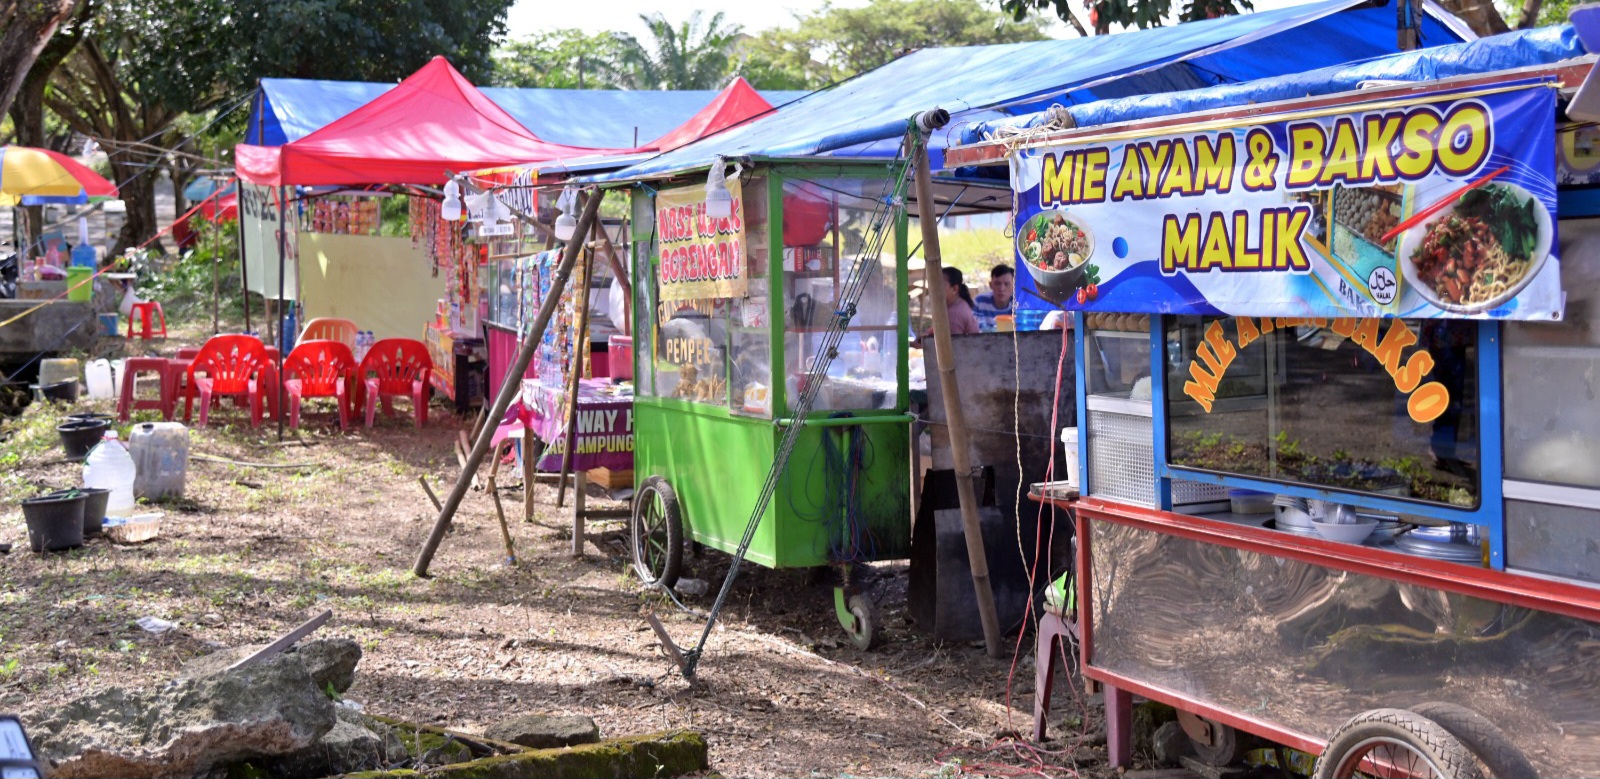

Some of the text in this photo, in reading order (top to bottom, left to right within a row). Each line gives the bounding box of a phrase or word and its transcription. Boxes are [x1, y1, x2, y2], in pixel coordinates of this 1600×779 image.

[1041, 149, 1107, 206] MIE
[1113, 138, 1236, 199] AYAM
[1244, 127, 1281, 190] &
[1288, 106, 1491, 185] BAKSO
[659, 204, 694, 244] NASI
[1161, 208, 1312, 272] MALIK
[661, 240, 741, 283] GORENGAN
[666, 337, 711, 364] PEMPEK
[1183, 319, 1237, 413] MIE
[576, 409, 618, 433] WAY
[574, 433, 634, 454] AMPUNG
